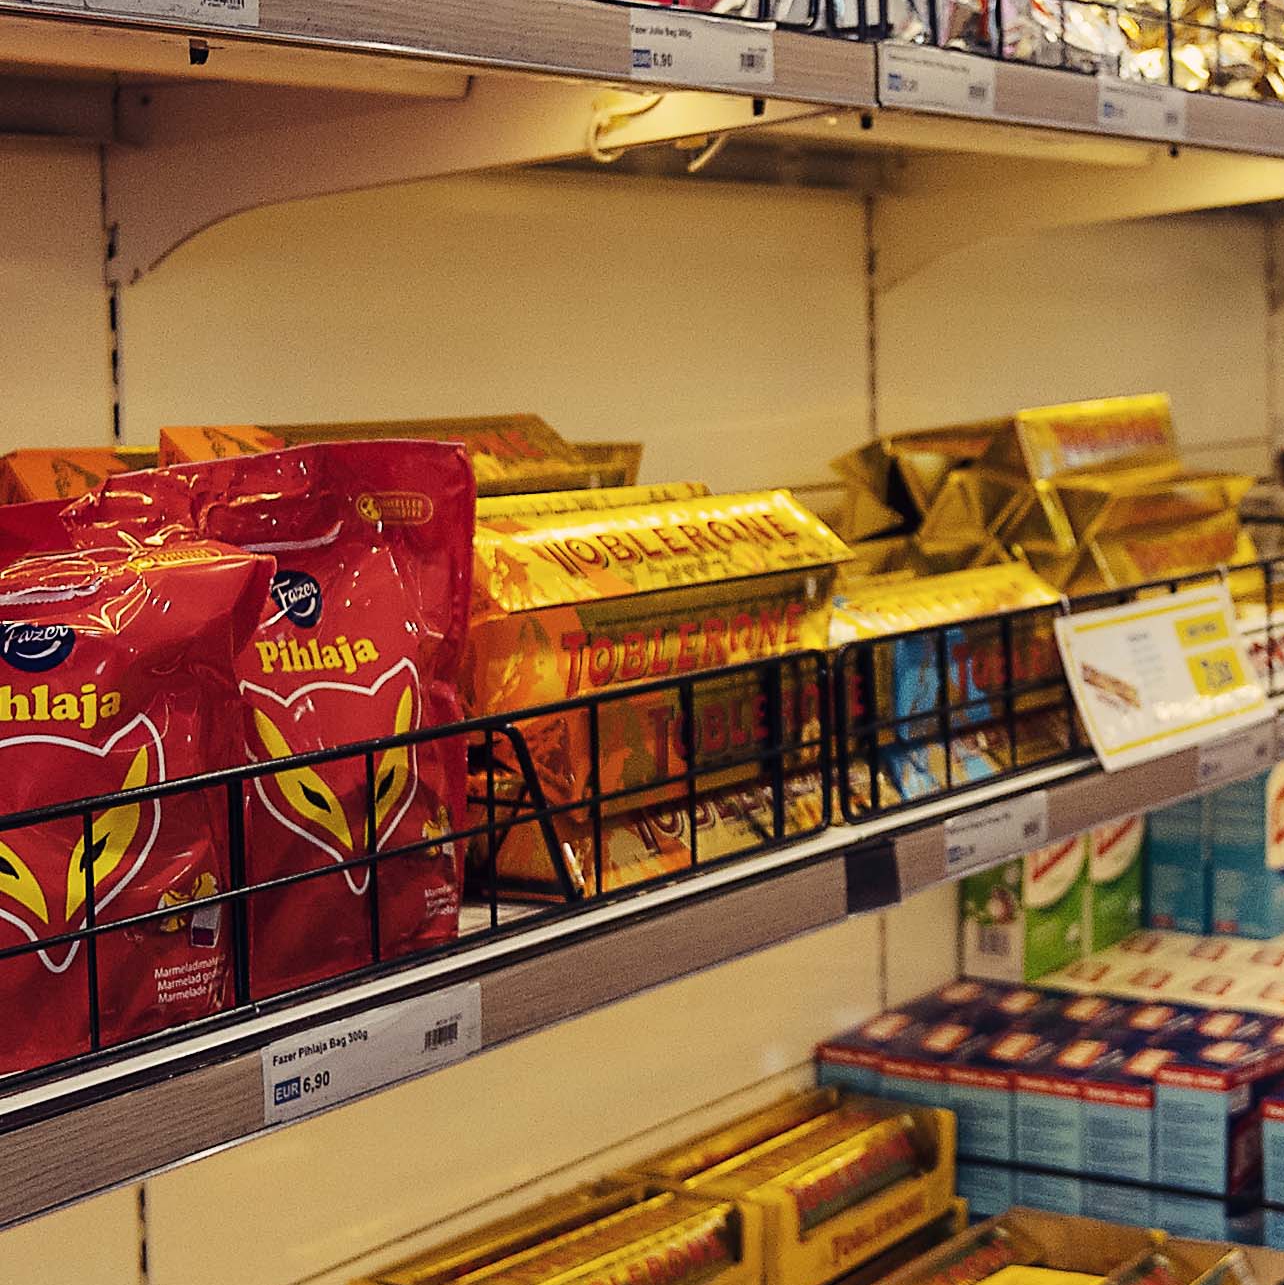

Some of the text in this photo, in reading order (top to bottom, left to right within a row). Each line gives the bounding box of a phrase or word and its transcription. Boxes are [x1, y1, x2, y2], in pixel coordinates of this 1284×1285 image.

[272, 577, 320, 612] Fazer
[3, 622, 70, 656] Fazer
[255, 635, 379, 674] Pihlaja
[561, 603, 806, 699] TOBLERONE
[272, 1029, 368, 1067] Fazer Pihlaja Bag 300g
[275, 1070, 331, 1102] EUR 6,90
